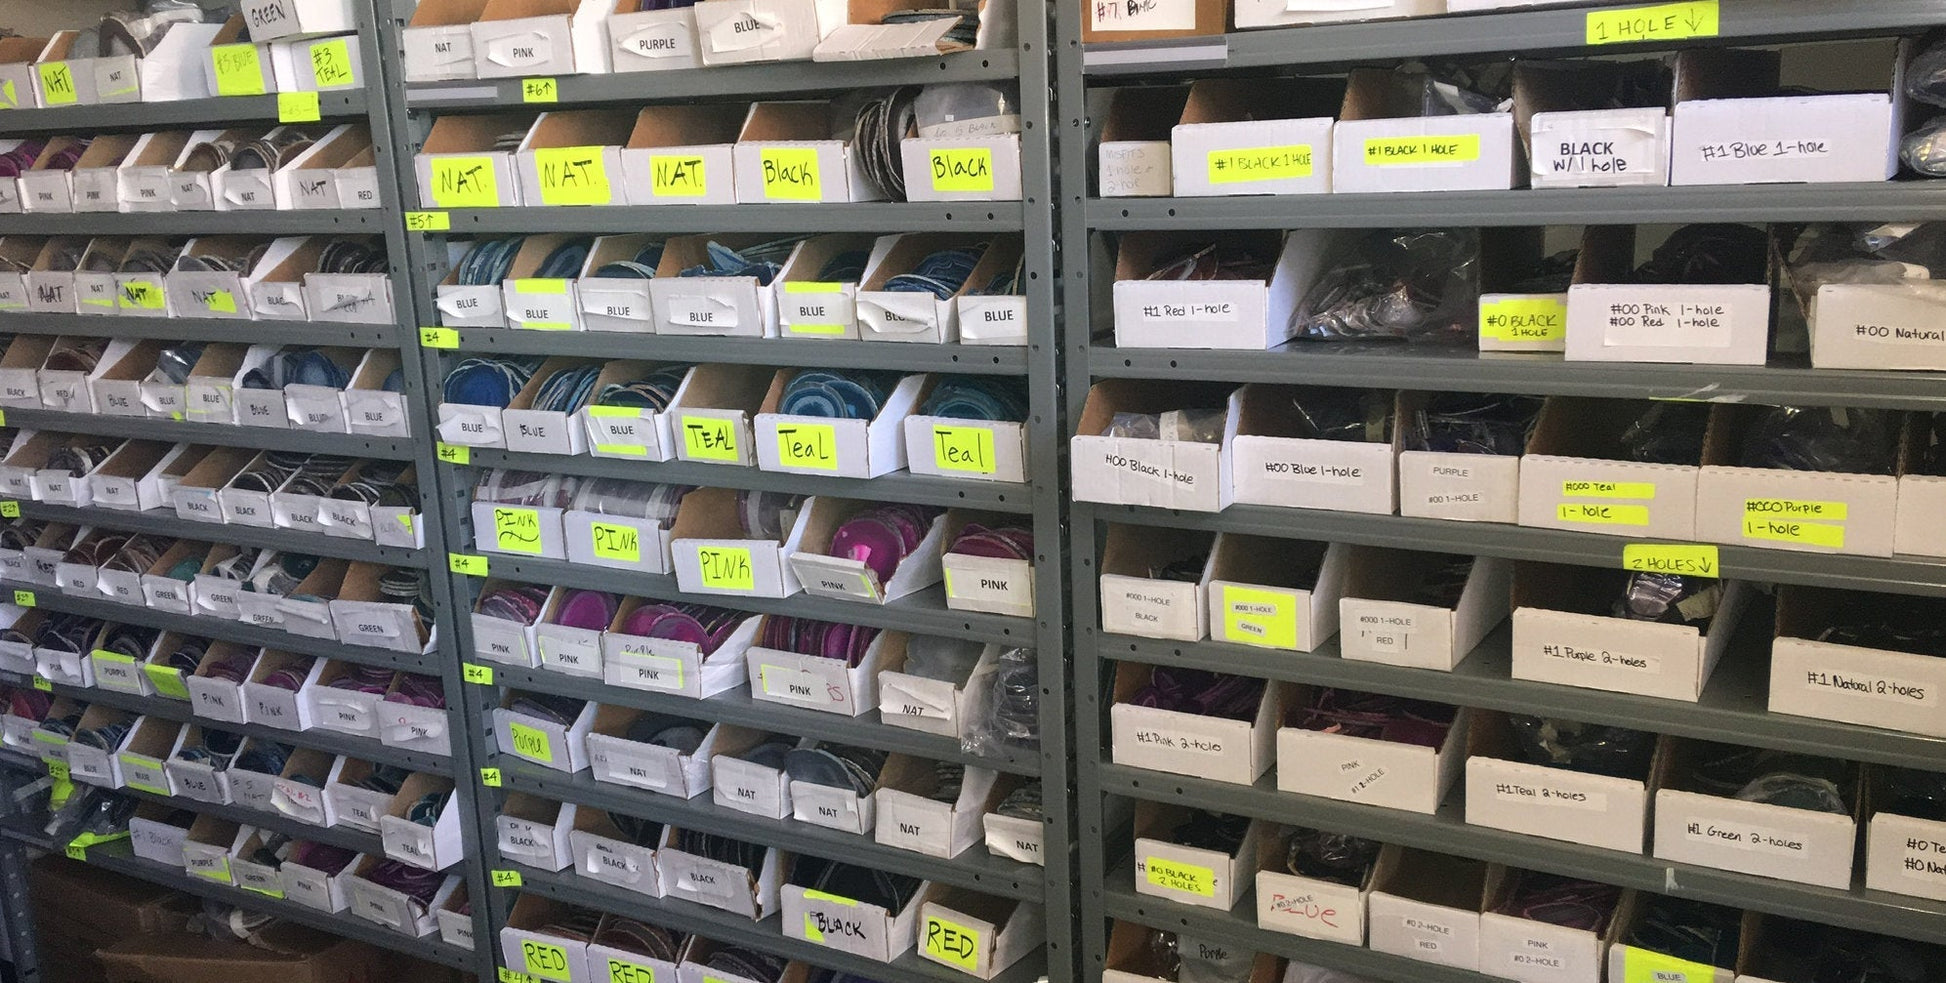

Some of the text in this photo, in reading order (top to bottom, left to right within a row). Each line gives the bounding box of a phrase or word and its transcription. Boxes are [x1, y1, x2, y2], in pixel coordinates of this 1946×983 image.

[252, 2, 286, 27] GREEN
[1596, 15, 1676, 40] 1 HOLE
[435, 42, 451, 53] NAT
[639, 38, 675, 50] PURPLE
[313, 47, 333, 65] #3
[513, 47, 534, 58] PINK
[316, 64, 347, 83] TEAL
[526, 83, 543, 96] #6
[1384, 144, 1417, 157] BLACK
[1431, 143, 1459, 155] HOLE
[1560, 142, 1614, 156] BLACK
[1701, 140, 1829, 161] #1 Blue 1-hole
[932, 154, 987, 179] Black
[1238, 156, 1280, 170] BLACK
[1284, 153, 1290, 167] 1
[1292, 152, 1311, 167] HOLE
[1591, 157, 1628, 173] hole
[656, 160, 702, 188] NAT.
[763, 158, 813, 186] Black
[140, 188, 156, 198] PINK
[181, 183, 193, 193] NAT
[299, 180, 326, 197] NAT
[358, 190, 373, 200] RED
[409, 215, 425, 228] #5
[90, 284, 104, 293] NAT
[192, 290, 217, 304] NAT
[457, 298, 478, 309] BLUE
[1610, 303, 1724, 316] #00 Pink 1-hole
[526, 309, 549, 319] BLUE
[607, 306, 630, 316] BLUE
[800, 306, 825, 317] BLUE
[984, 310, 1014, 321] BLUE
[1143, 303, 1231, 317] #1 Red 1-hole
[689, 312, 713, 322] BLUE
[1487, 314, 1557, 327] #0 BLACK
[1609, 315, 1720, 328] #00 Red 1-hole
[1512, 328, 1548, 337] 1 HOLE
[1855, 324, 1945, 341] #00 Natural
[203, 394, 220, 404] BLUE
[365, 412, 383, 422] BLUE
[461, 422, 483, 433] BLUE
[610, 425, 634, 435] BLUE
[687, 424, 734, 451] TEAL
[441, 447, 456, 459] #4
[935, 430, 984, 468] Teal
[1129, 461, 1160, 478] Black
[1164, 468, 1194, 485] 1-hole
[1265, 462, 1361, 478] #00 Blue 1-hole
[1433, 466, 1468, 477] PURPLE
[1593, 482, 1616, 491] Teal
[187, 502, 208, 512] BLACK
[235, 506, 256, 516] BLACK
[1786, 501, 1822, 514] Purple
[291, 513, 313, 523] BLACK
[332, 513, 356, 526] BLACK
[495, 509, 538, 530] PINK
[594, 526, 638, 551] PINK
[454, 558, 470, 569] #4
[700, 550, 750, 581] PINK
[1632, 558, 1696, 571] 2 HOLES
[821, 580, 846, 591] PINK
[980, 579, 1008, 591] PINK
[155, 590, 176, 600] GREEN
[211, 594, 233, 604] GREEN
[1143, 595, 1171, 606] 1-HOLE
[1135, 612, 1158, 622] BLACK
[1380, 616, 1412, 626] 1-HOLE
[358, 624, 384, 633] GREEN
[1376, 636, 1394, 645] RED
[491, 643, 510, 654] PINK
[559, 654, 579, 664] PINK
[1544, 645, 1647, 668] #1 Purple 2-holes
[638, 668, 659, 680] PINK
[789, 684, 811, 696] PINK
[1808, 671, 1924, 700] #1 Natural 2-holes
[202, 692, 225, 707] PINK
[259, 702, 283, 716] PINK
[902, 704, 924, 716] NAT
[338, 712, 357, 722] PINK
[411, 726, 428, 737] PINK
[512, 728, 544, 755] Purple
[1137, 732, 1152, 744] #1
[1153, 732, 1175, 748] Pink
[630, 767, 647, 777] NAT
[1341, 760, 1360, 772] PINK
[737, 787, 756, 799] NAT
[1496, 784, 1587, 802] #1 Teal 2-holes
[818, 806, 838, 818] NAT
[900, 823, 920, 836] NAT
[510, 836, 534, 847] BLACK
[1707, 825, 1741, 842] Green
[1751, 833, 1802, 850] 2-holes
[1016, 840, 1038, 852] NAT
[602, 856, 627, 869] BLACK
[497, 873, 514, 883] #4
[691, 873, 715, 885] BLACK
[1165, 868, 1196, 882] BLACK
[1171, 879, 1201, 892] HOLES
[816, 912, 866, 940] BLACK
[927, 921, 974, 960] RED
[1420, 941, 1437, 950] RED
[1527, 940, 1548, 949] PINK
[524, 943, 566, 971] RED
